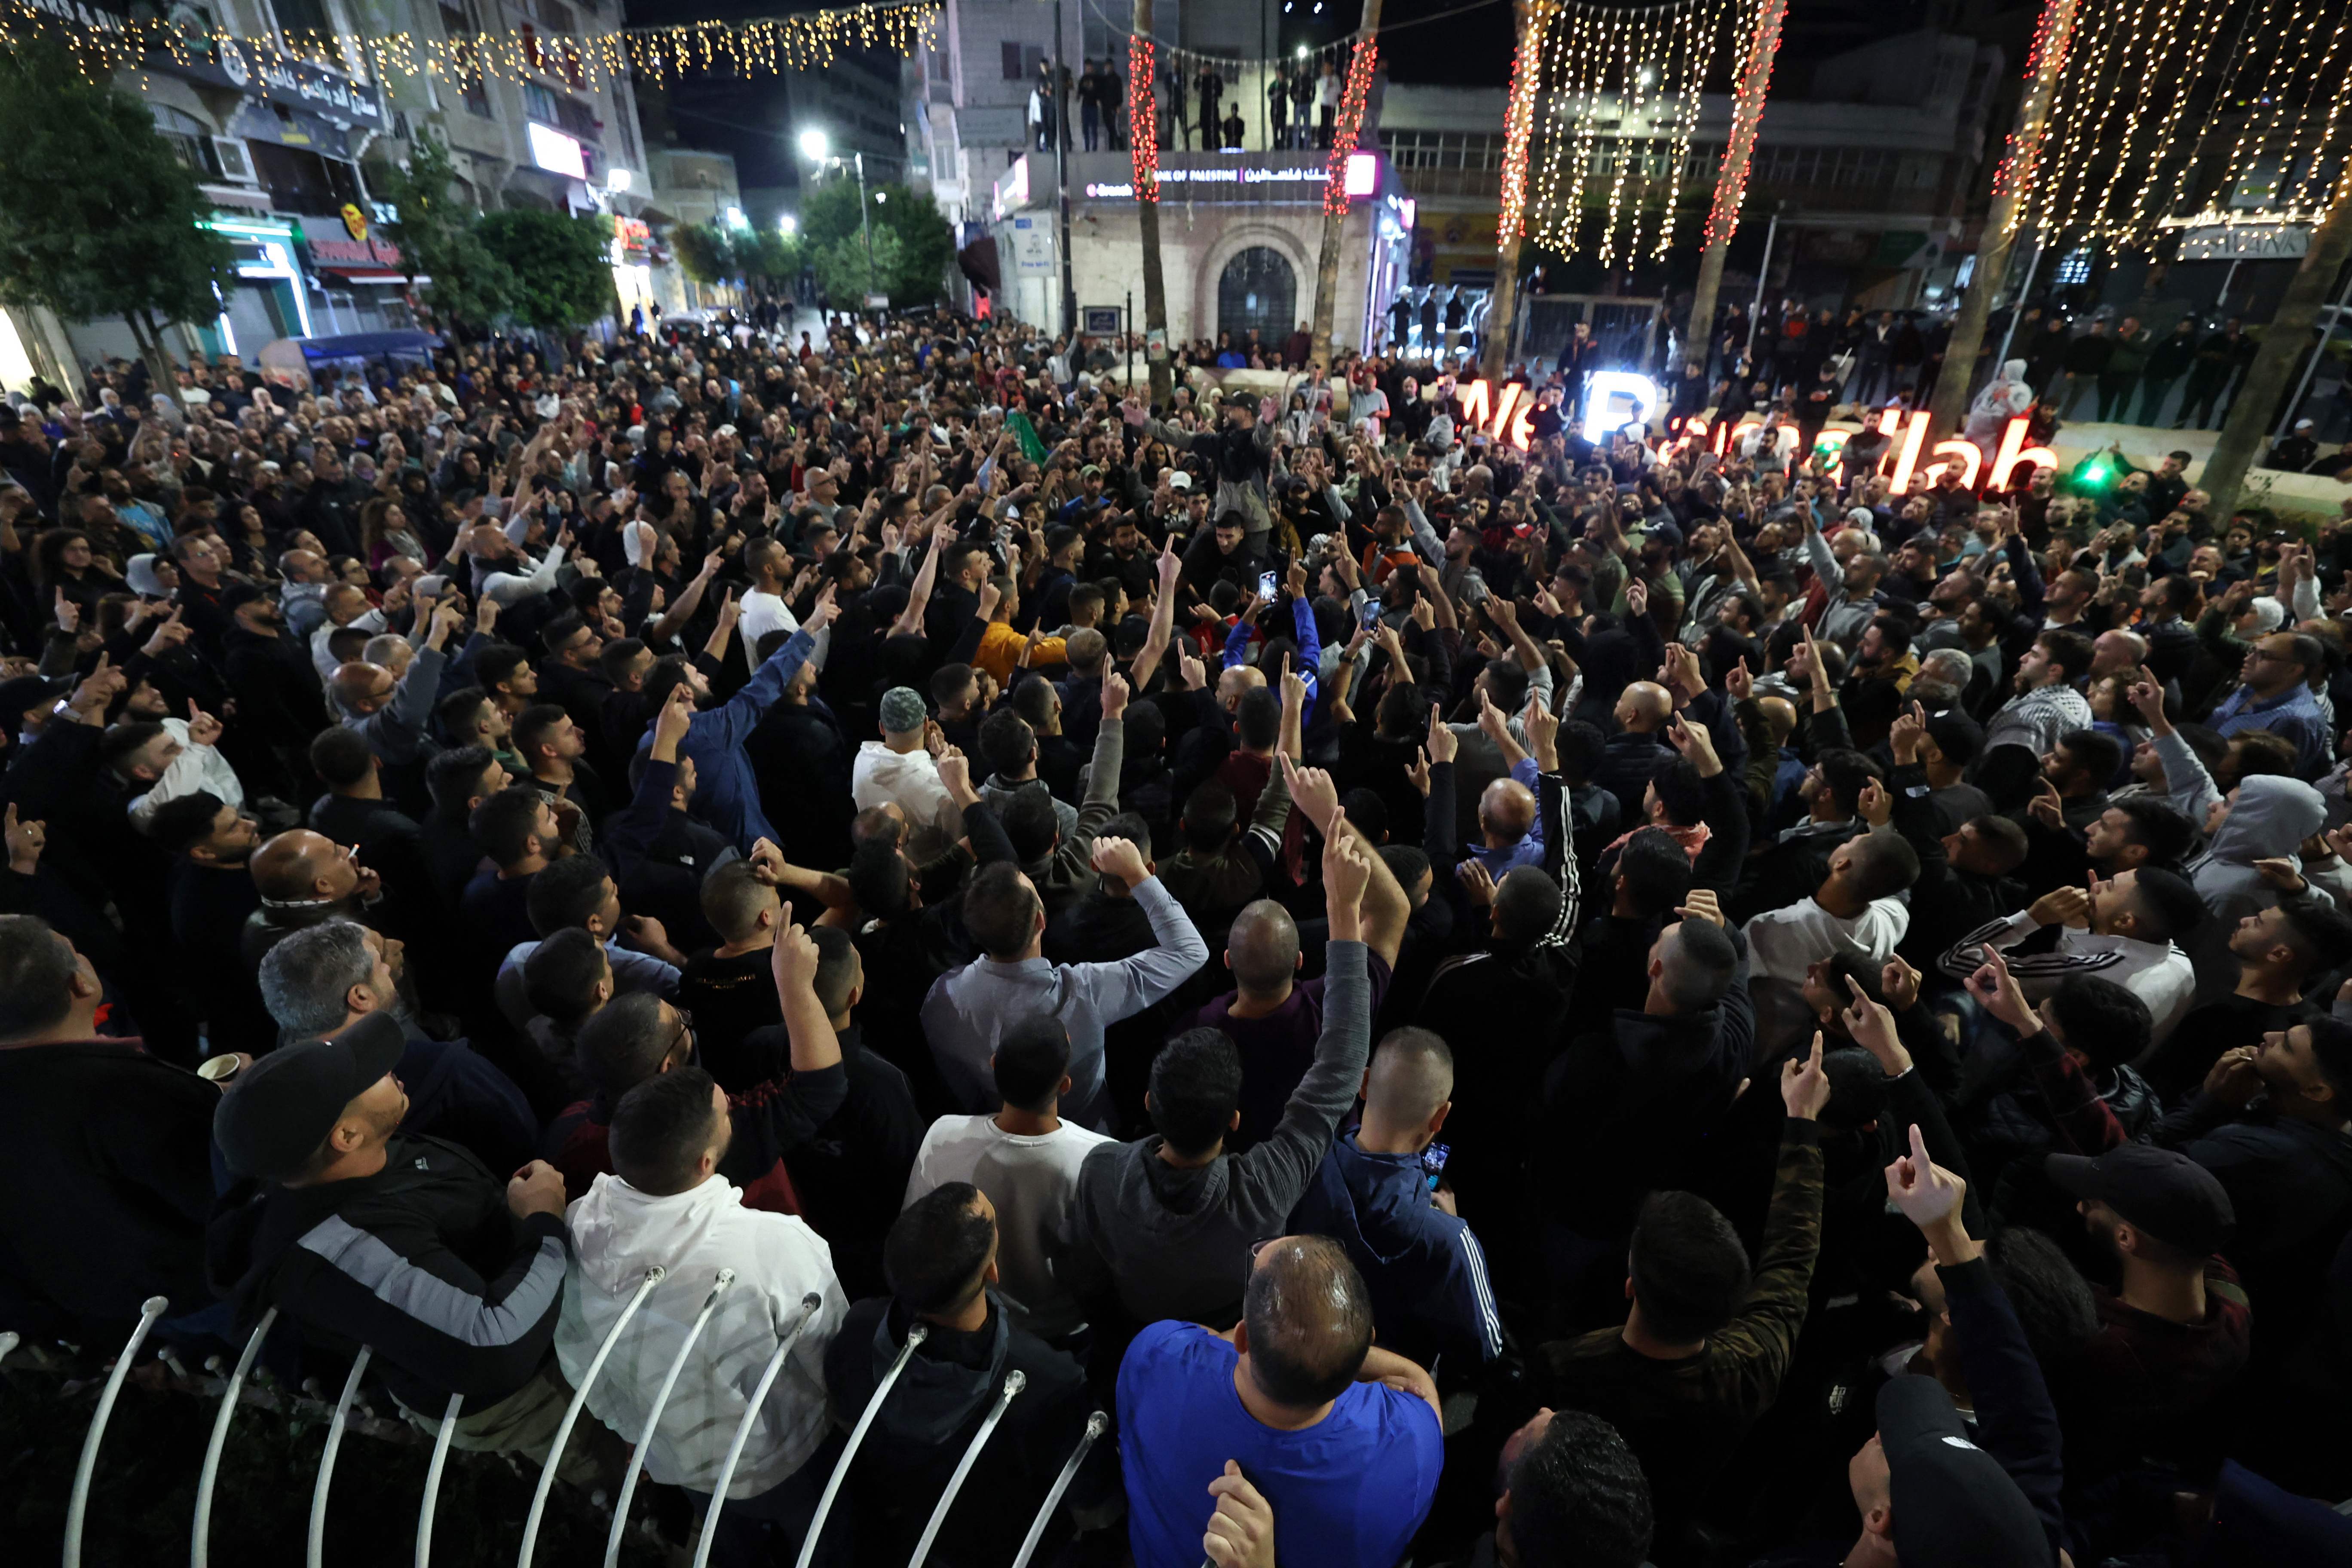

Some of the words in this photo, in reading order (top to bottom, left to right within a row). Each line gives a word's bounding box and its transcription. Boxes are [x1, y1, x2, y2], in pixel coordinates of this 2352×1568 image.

[1153, 170, 1172, 182] ANK
[1189, 170, 1238, 182] PALESTINE
[1244, 167, 1302, 183] فلسطين
